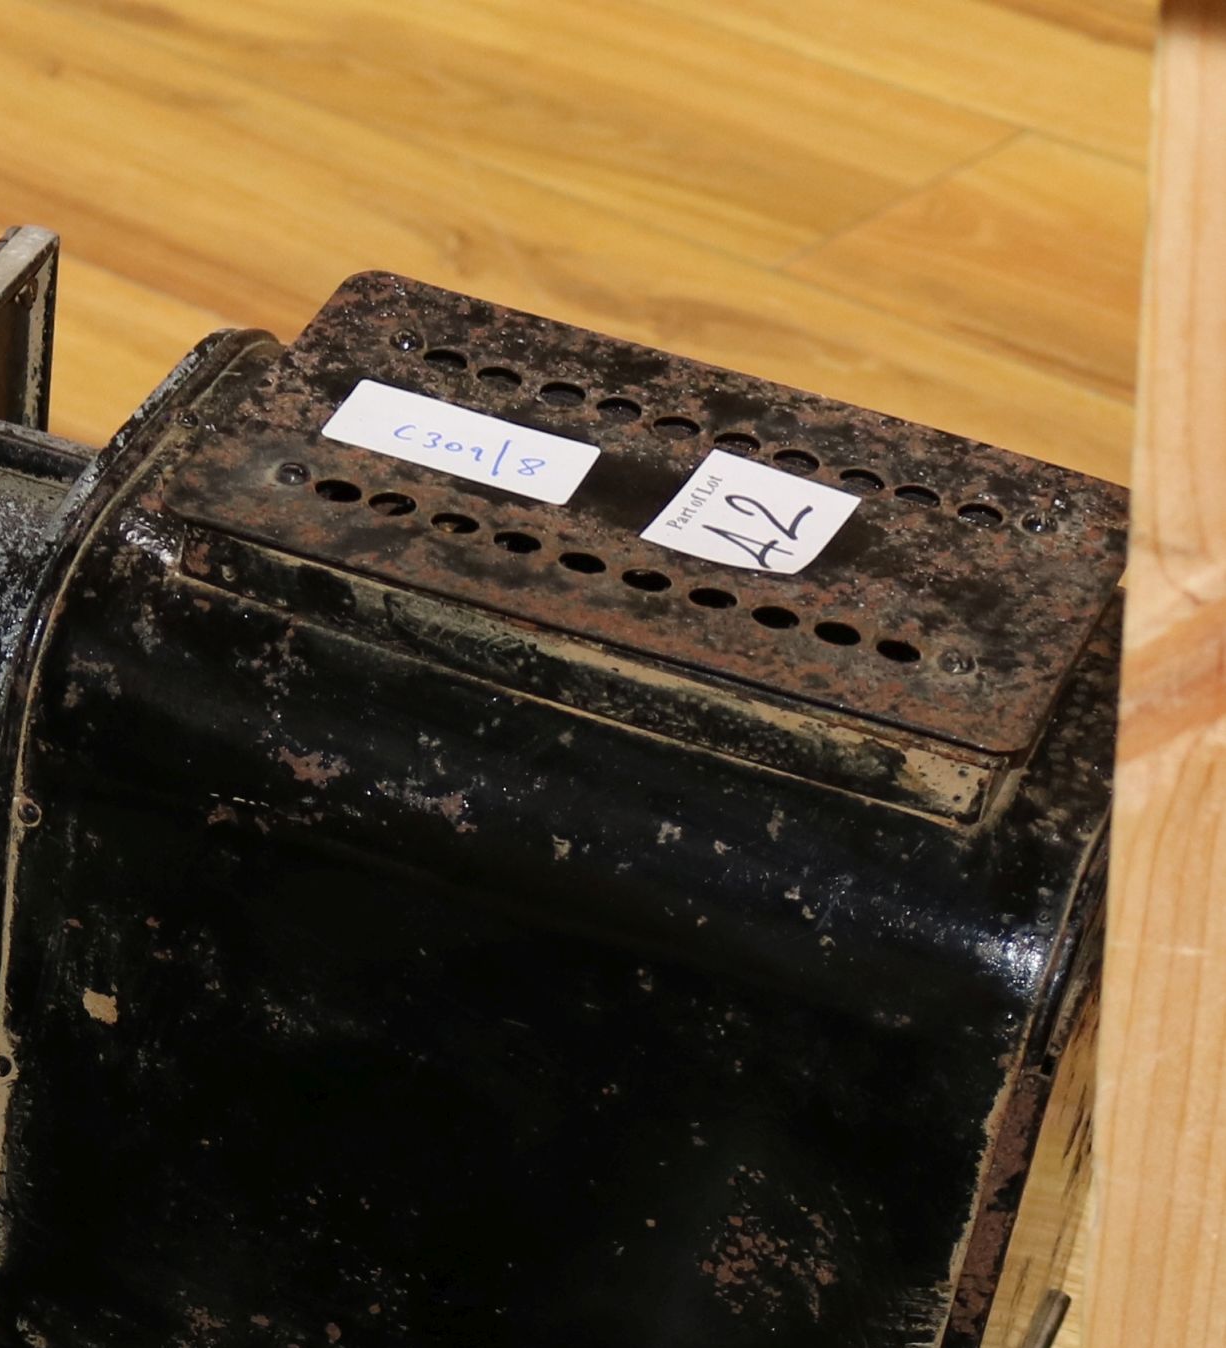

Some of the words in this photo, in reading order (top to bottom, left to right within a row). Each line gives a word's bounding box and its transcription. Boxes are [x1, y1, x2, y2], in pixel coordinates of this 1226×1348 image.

[696, 474, 723, 495] Lot
[695, 491, 708, 512] of
[666, 503, 698, 530] Part
